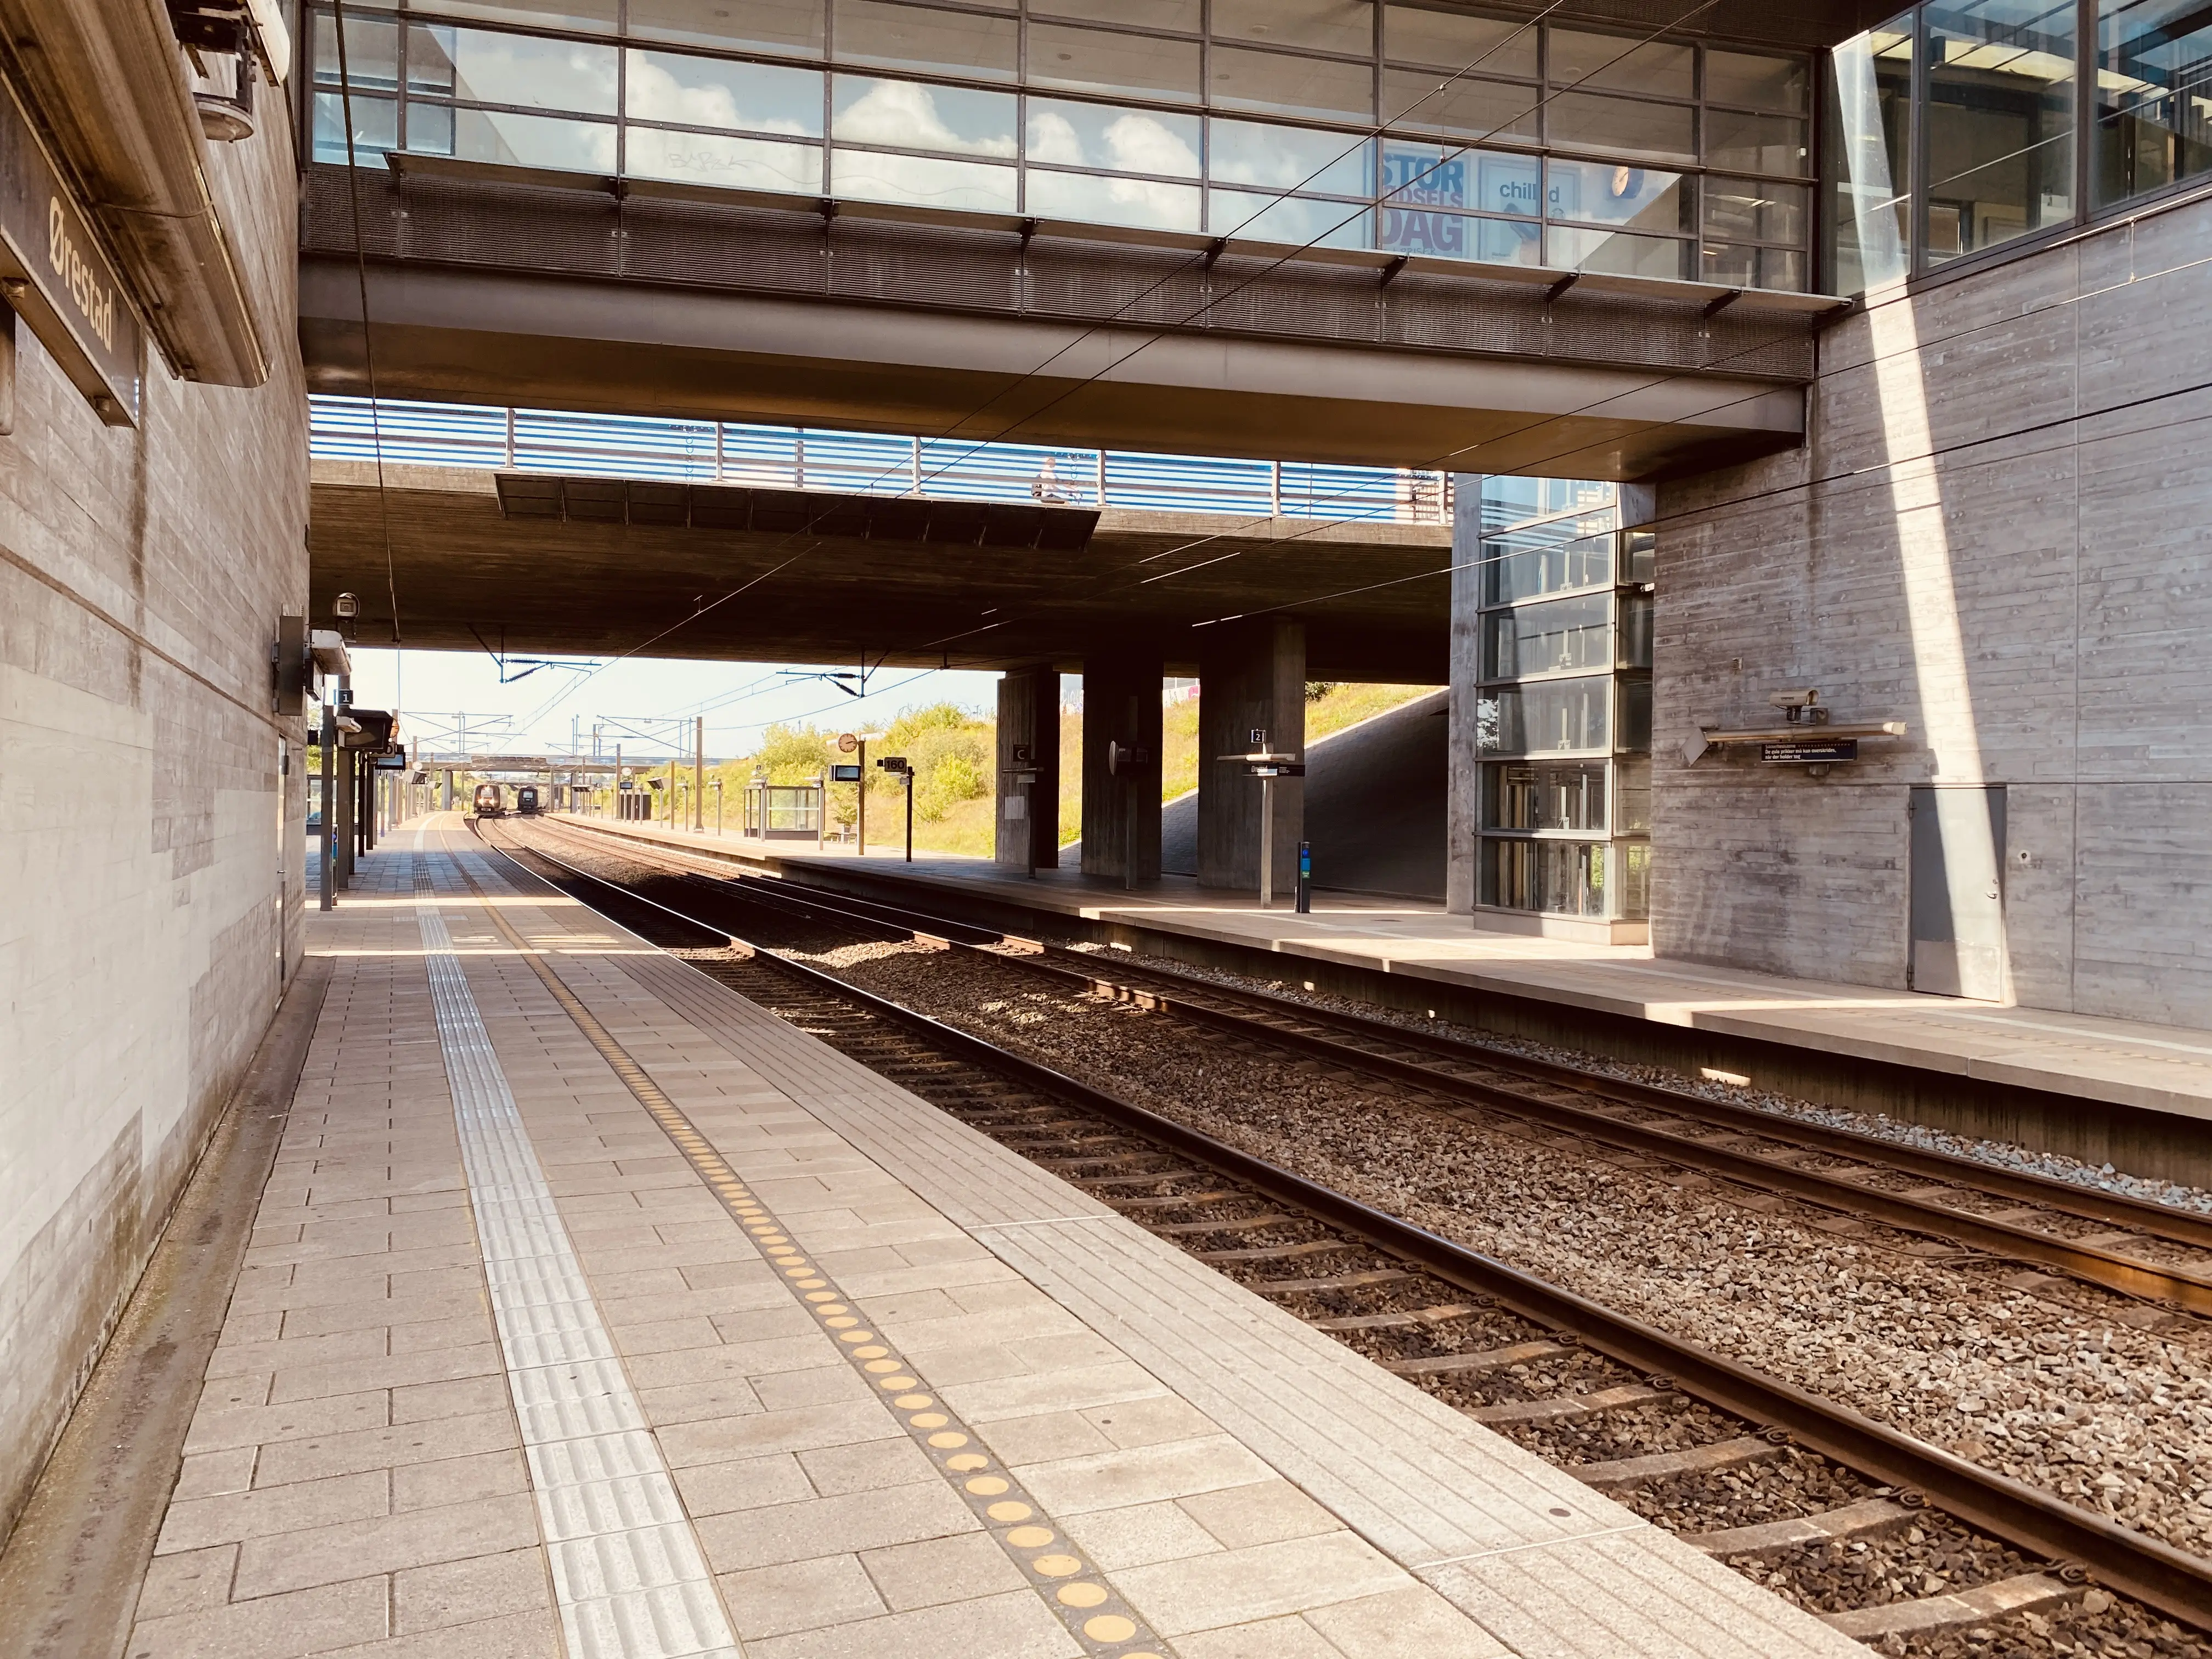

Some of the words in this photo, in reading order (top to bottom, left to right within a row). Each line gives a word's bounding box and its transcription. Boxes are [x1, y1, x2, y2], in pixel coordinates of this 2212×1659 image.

[1383, 153, 1464, 193] STOR
[1499, 181, 1560, 204] chilld
[1382, 209, 1463, 252] DAG
[49, 196, 112, 354] Ørestad
[343, 693, 349, 703] 1
[886, 760, 905, 770] 160
[1017, 749, 1025, 760] C
